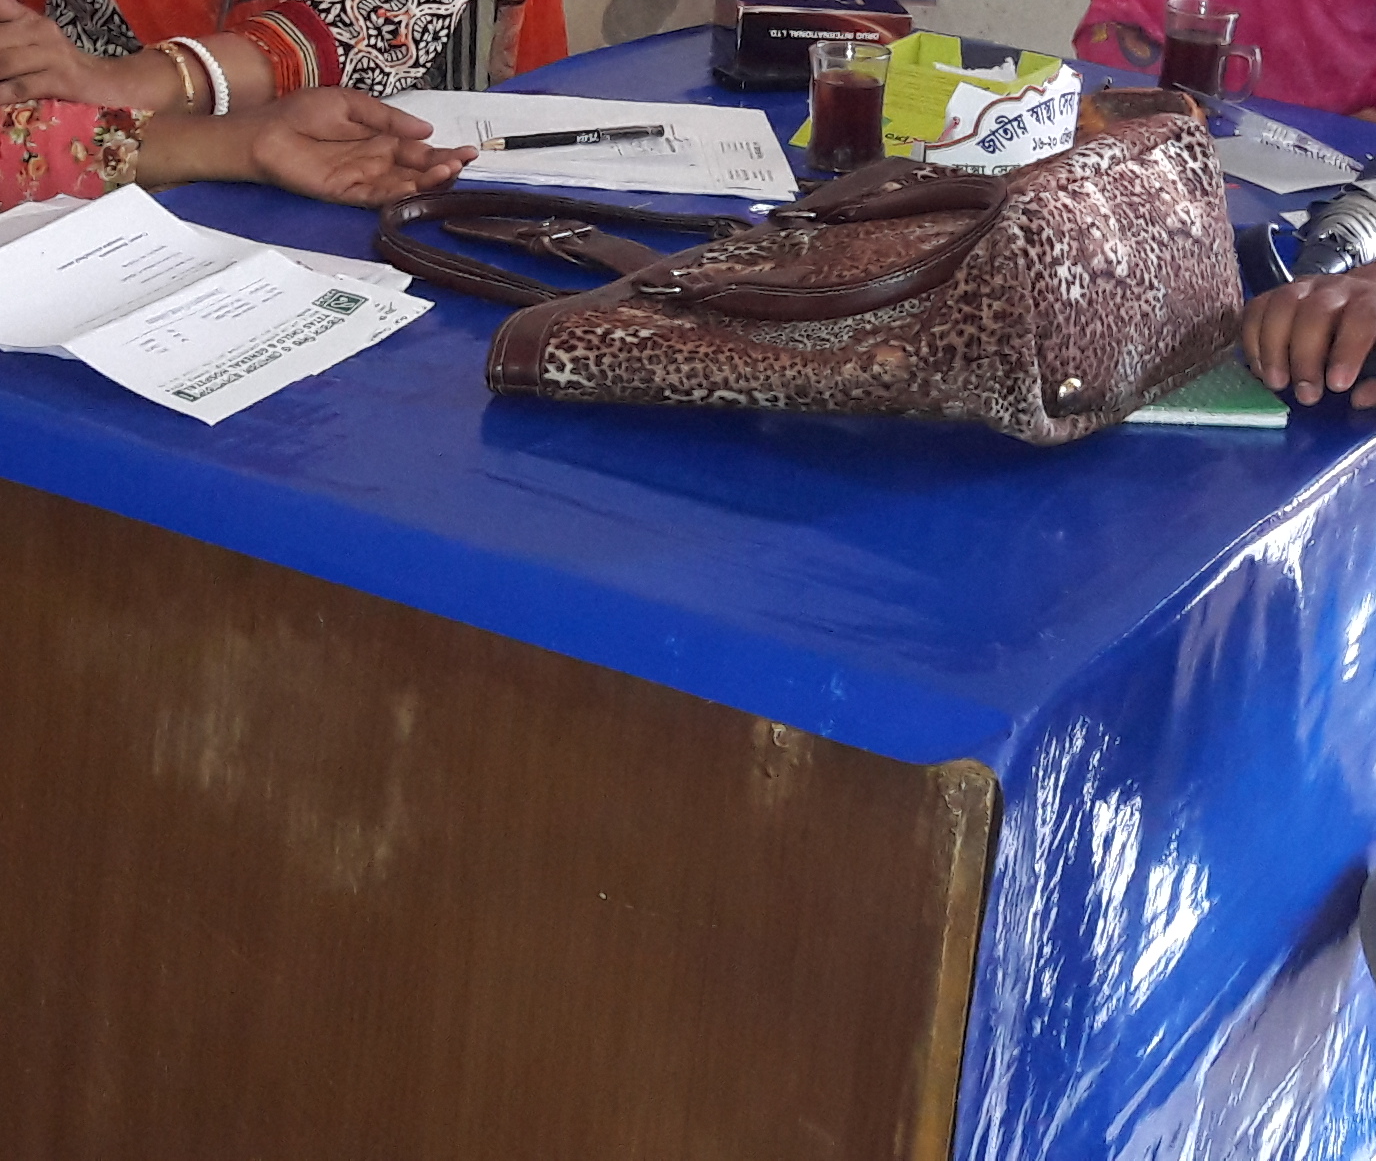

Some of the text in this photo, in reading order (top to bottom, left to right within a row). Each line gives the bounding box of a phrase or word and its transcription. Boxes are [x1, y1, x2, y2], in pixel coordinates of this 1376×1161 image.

[789, 29, 854, 40] INTERNATIONAL
[856, 32, 880, 40] DRUG
[975, 115, 1029, 154] জাতীয়
[1026, 97, 1055, 126] স্বাস্থ্য
